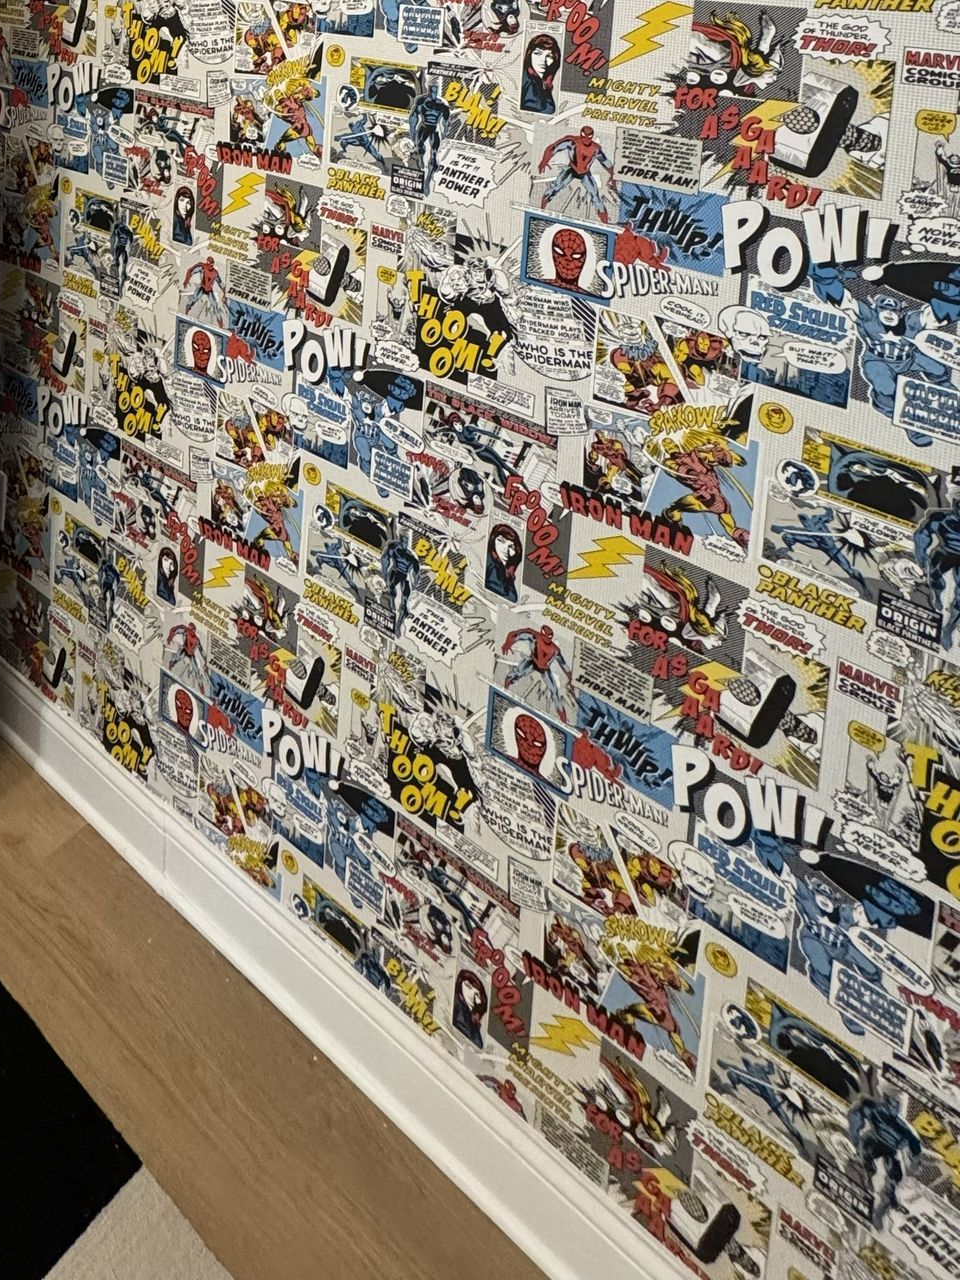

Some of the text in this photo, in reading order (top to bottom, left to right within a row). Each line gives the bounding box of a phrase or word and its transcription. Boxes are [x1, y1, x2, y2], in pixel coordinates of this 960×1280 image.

[798, 35, 877, 58] THOR!
[819, 27, 870, 42] THUNDER,
[840, 22, 868, 33] GOD
[46, 60, 100, 111] POW!
[585, 92, 659, 114] MARVEL
[587, 75, 661, 96] MIGHTY
[673, 86, 717, 108] FOR
[216, 141, 293, 176] IRON MAN
[616, 164, 698, 190] SPIDER-MAN!
[437, 176, 480, 198] POWER
[629, 195, 723, 259] THWIP!
[721, 200, 892, 288] POW!
[595, 259, 718, 300] SPIDER-MAN!
[749, 289, 849, 334] RED SKULL
[234, 309, 284, 360] THWIP!
[282, 319, 367, 383] POW!
[518, 341, 548, 357] WHO
[569, 348, 593, 361] THE
[216, 353, 281, 386] SPIDER-MAN!
[518, 350, 591, 371] SPIDERMAN
[560, 481, 694, 558] IRON MAN
[547, 580, 616, 620] MIGHTY
[756, 579, 866, 634] PANTHER
[772, 569, 857, 611] BLACK
[545, 595, 614, 637] MARVEL
[627, 619, 667, 652] FOR
[741, 613, 813, 656] THOR!
[880, 604, 937, 638] ORIGIN
[408, 624, 448, 657] POWER
[574, 672, 650, 721] SPIDER-MAN!
[836, 682, 896, 718] GROUP
[838, 660, 903, 704] MARVEL
[838, 675, 897, 710] COMICS
[215, 680, 262, 743] THWIP!
[261, 708, 342, 794] POW!
[586, 705, 673, 792] THWIP!
[554, 756, 668, 827] SPIDER-MAN!
[671, 744, 827, 869] POW!
[850, 827, 910, 866] NOW OR
[522, 949, 647, 1064] IRON MAN
